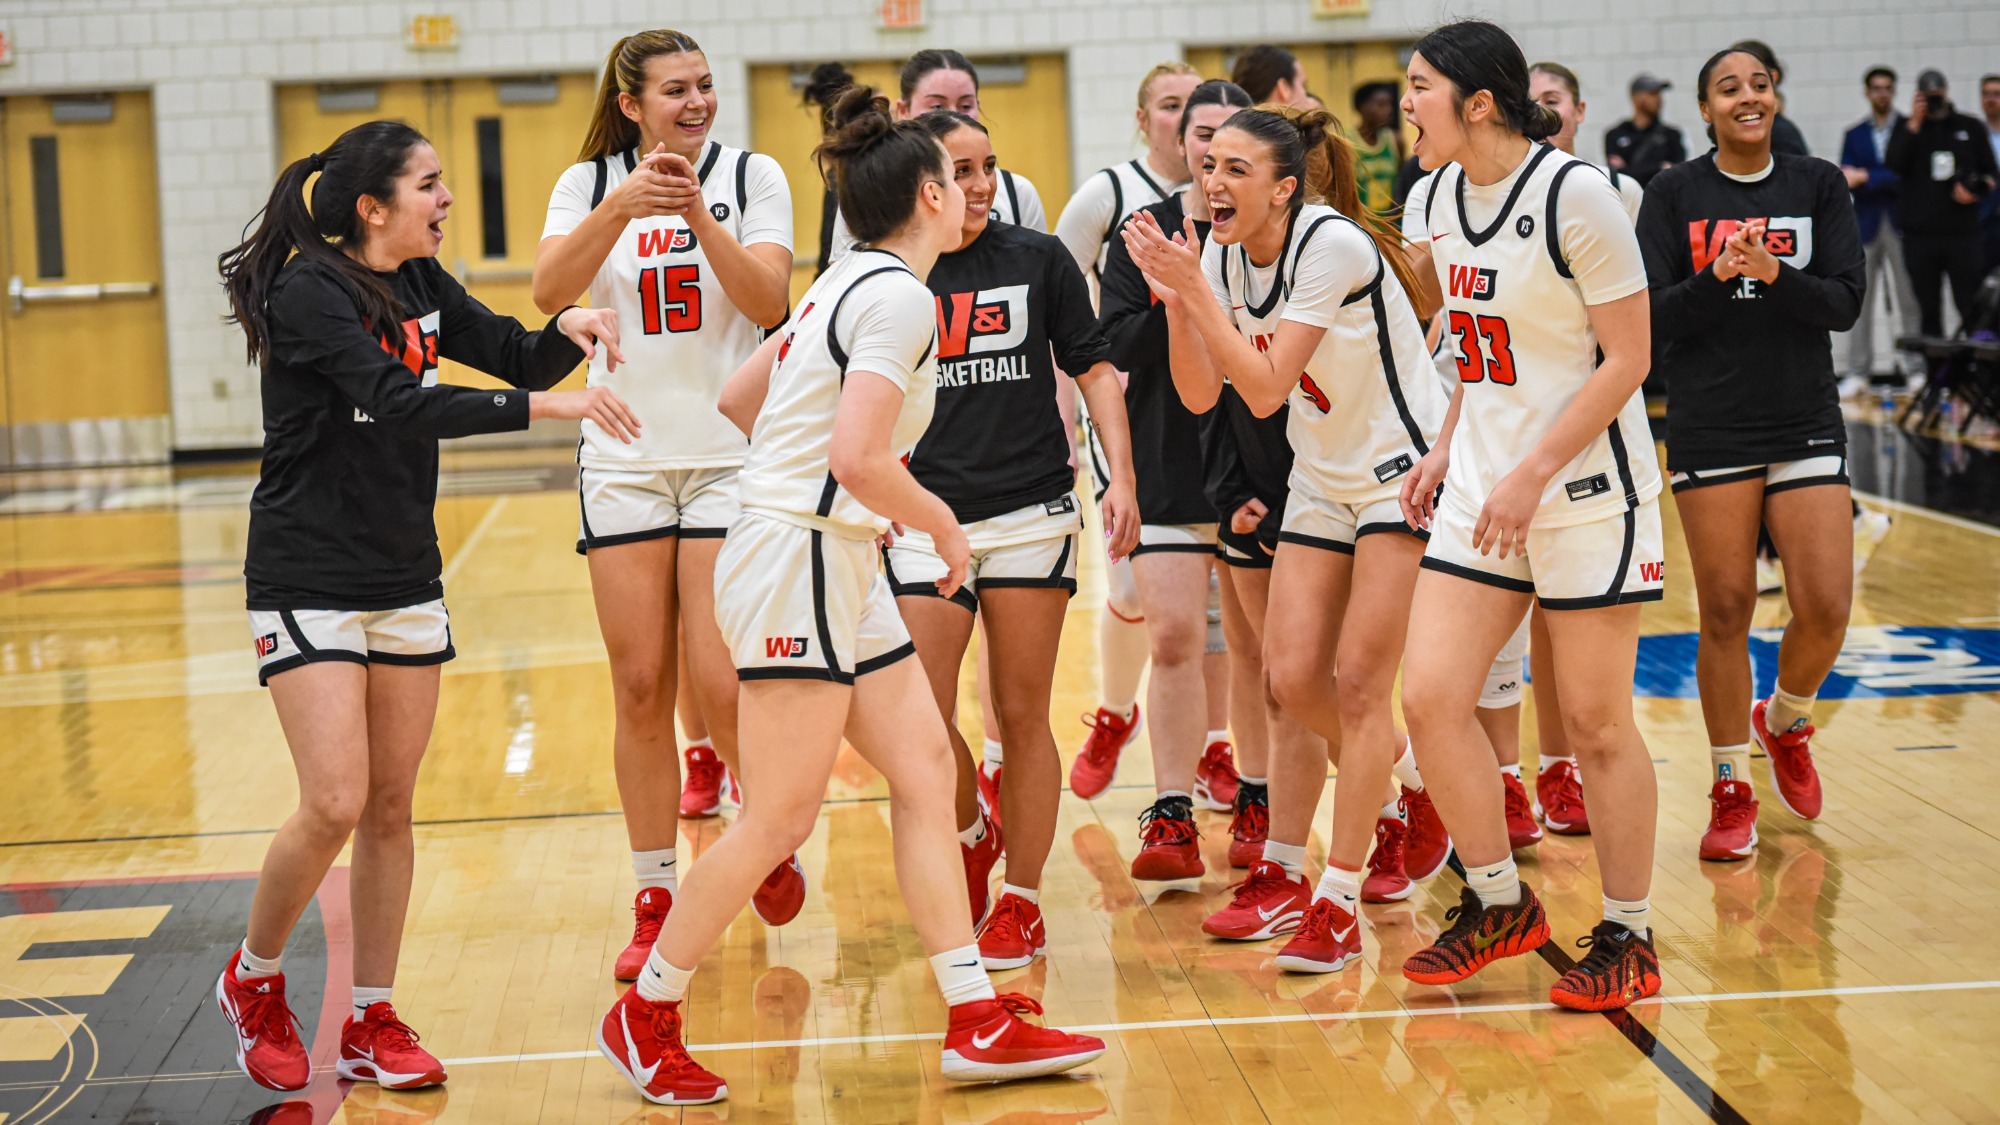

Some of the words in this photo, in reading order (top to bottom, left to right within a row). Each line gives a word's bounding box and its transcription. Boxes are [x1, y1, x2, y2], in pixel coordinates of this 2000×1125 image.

[715, 207, 724, 217] VS
[1521, 219, 1531, 233] VS
[638, 228, 697, 257] W&J
[1450, 264, 1498, 301] W&J
[638, 264, 702, 335] 15
[1449, 310, 1517, 387] 33
[1596, 480, 1603, 489] L
[766, 637, 808, 658] W&J
